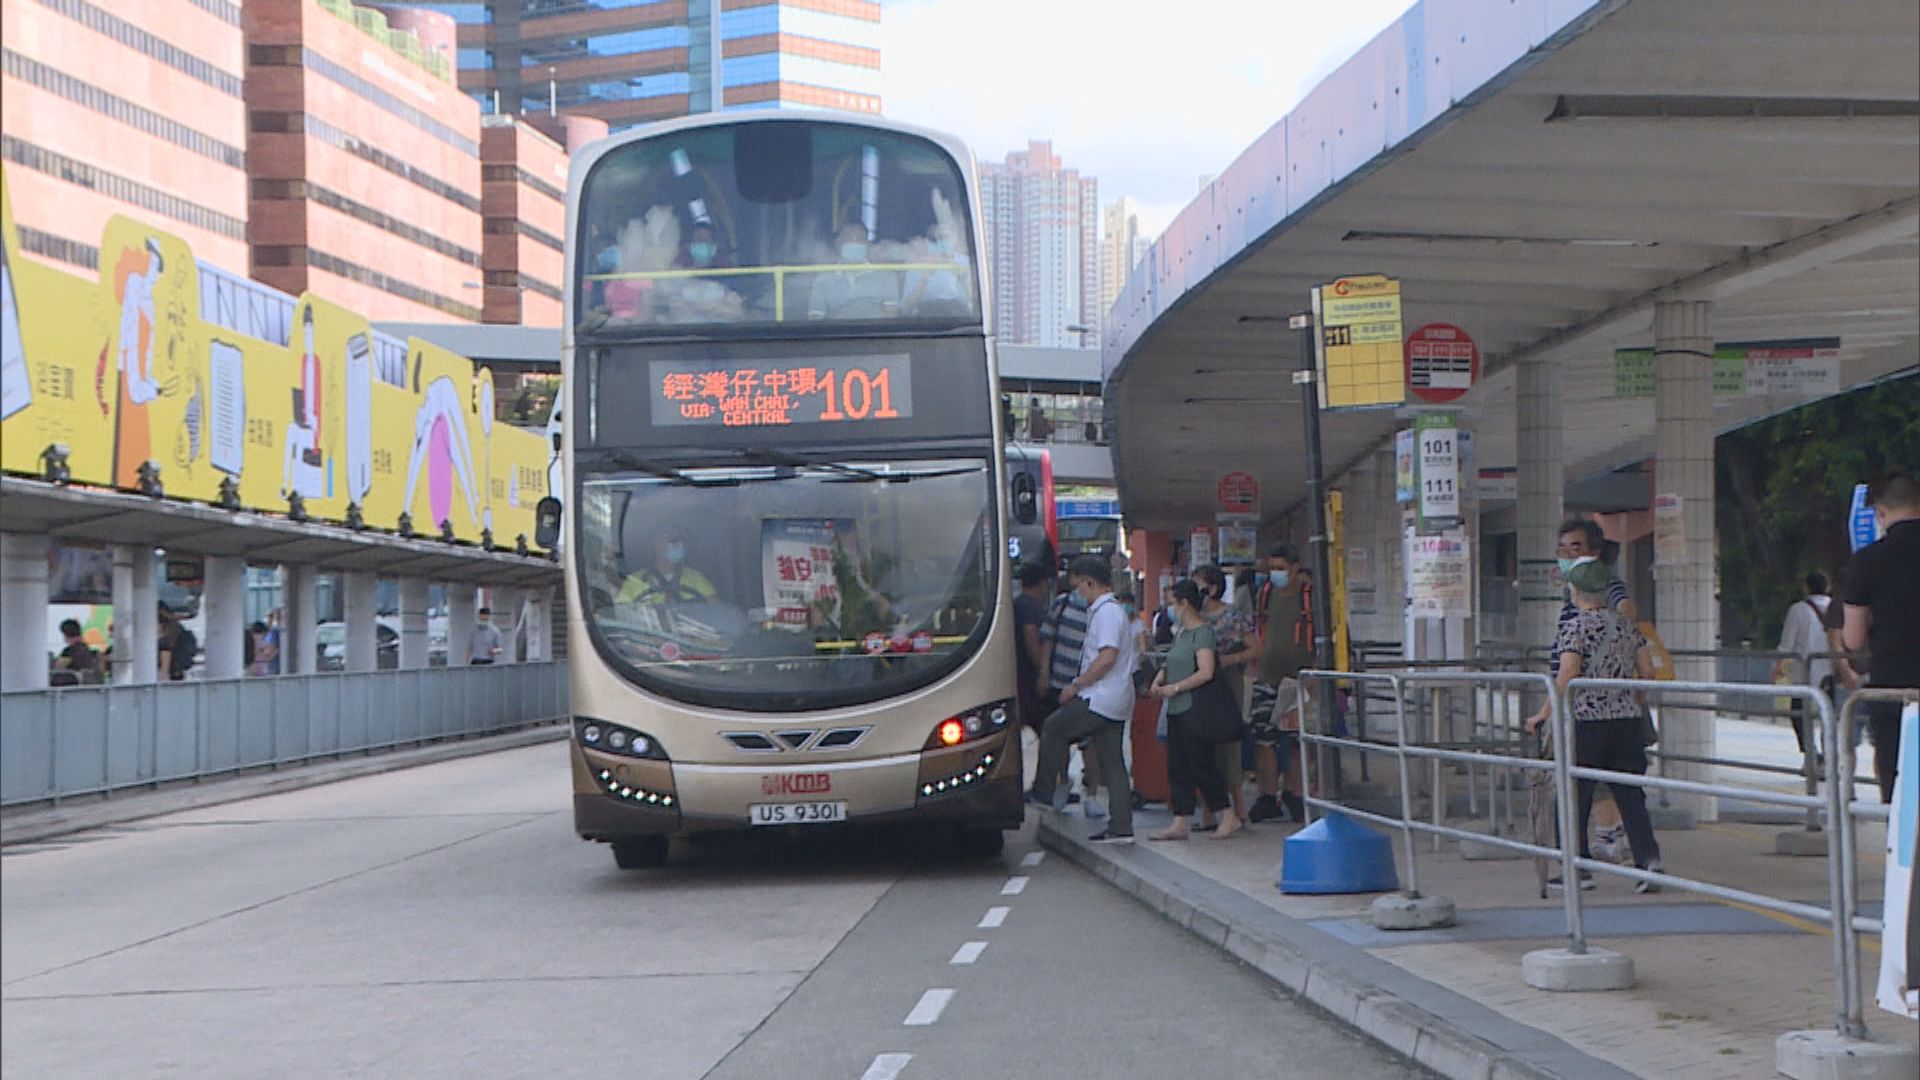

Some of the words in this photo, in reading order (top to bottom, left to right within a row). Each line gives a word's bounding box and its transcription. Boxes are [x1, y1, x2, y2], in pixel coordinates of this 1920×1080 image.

[817, 367, 898, 420] 101
[719, 396, 749, 411] WAN
[722, 410, 791, 426] CENTRAL
[1424, 440, 1451, 454] 101
[1425, 479, 1452, 493] 111
[782, 773, 832, 794] KMB
[760, 806, 785, 821] US
[795, 803, 838, 820] 9301
